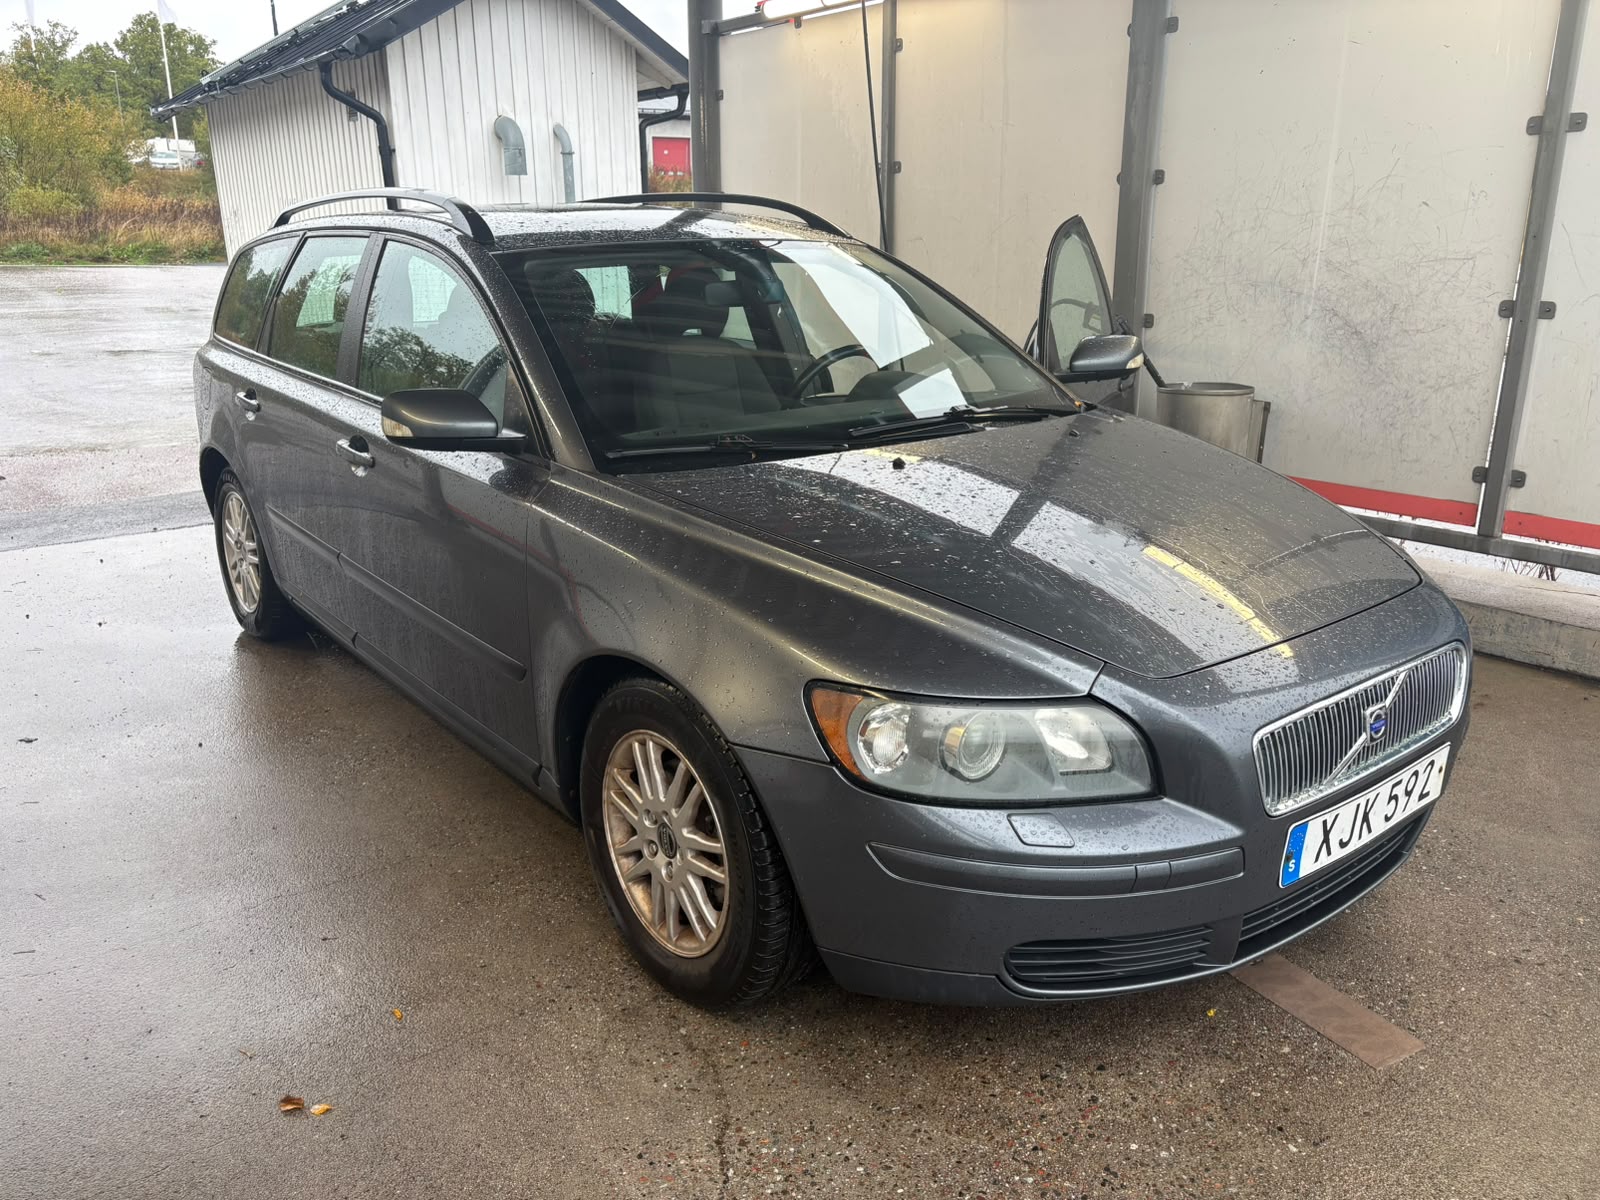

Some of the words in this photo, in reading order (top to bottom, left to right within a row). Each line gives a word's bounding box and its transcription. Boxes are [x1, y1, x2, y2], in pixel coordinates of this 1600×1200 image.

[1314, 792, 1380, 863] XJK
[1384, 759, 1435, 823] 592
[1288, 859, 1296, 872] S
